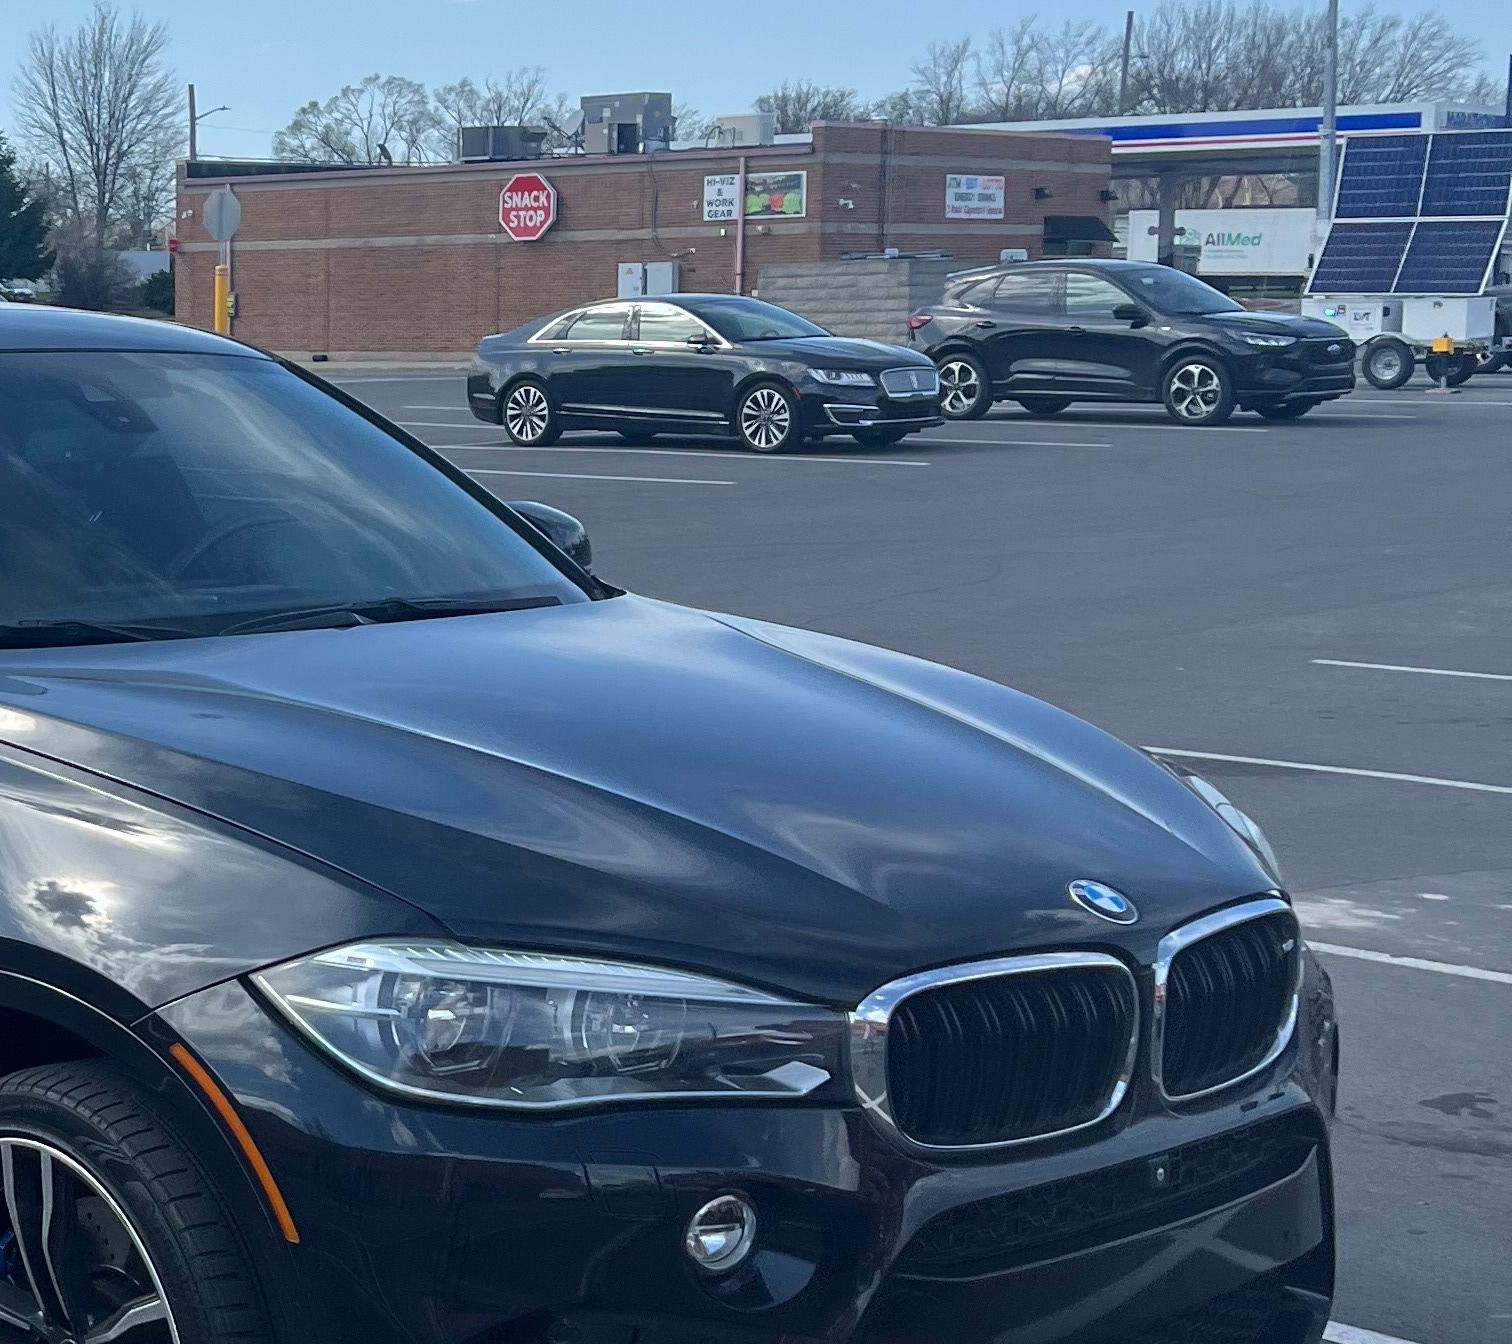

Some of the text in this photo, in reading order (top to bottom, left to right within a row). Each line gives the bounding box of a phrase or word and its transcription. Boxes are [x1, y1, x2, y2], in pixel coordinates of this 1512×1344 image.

[707, 176, 736, 187] HI-VIZ
[504, 190, 549, 209] SNACK
[707, 198, 735, 208] WORK
[509, 209, 545, 228] STOP
[707, 209, 733, 219] GEAR
[1204, 232, 1263, 247] AllMed
